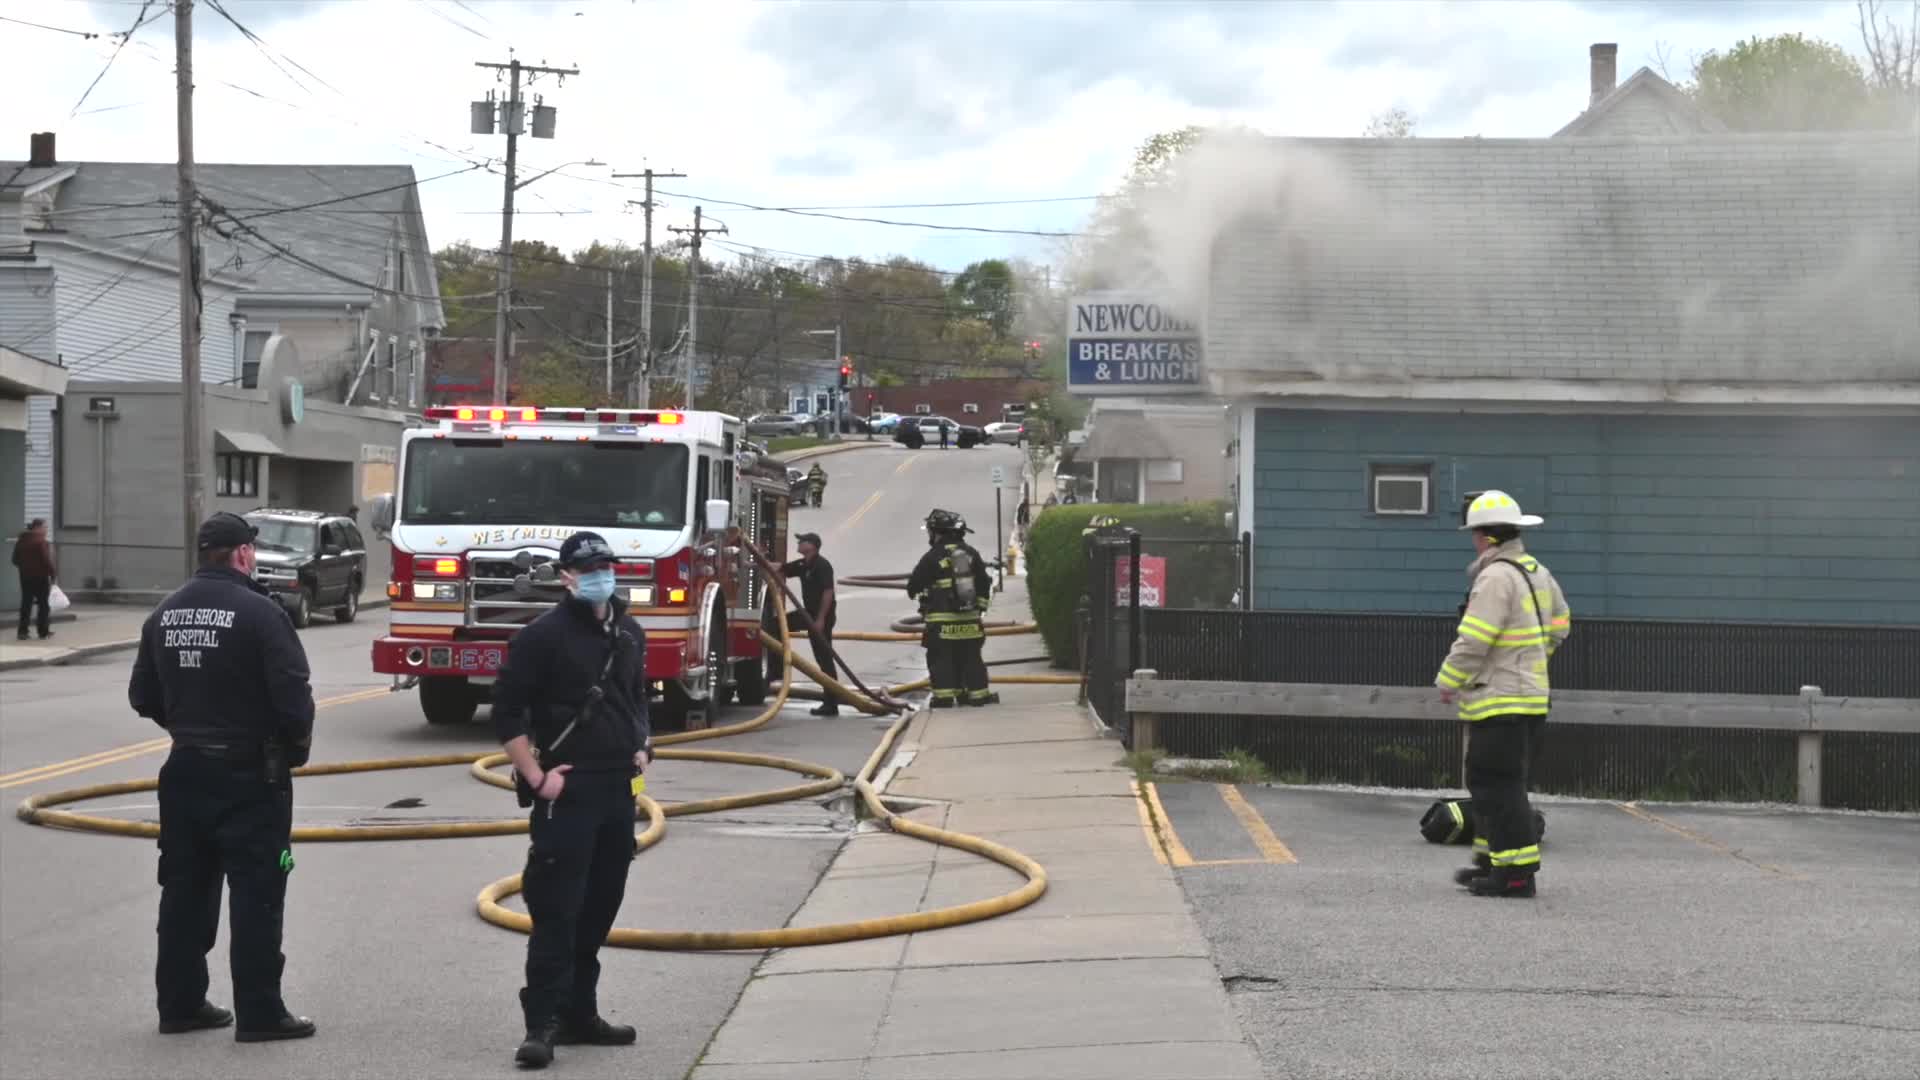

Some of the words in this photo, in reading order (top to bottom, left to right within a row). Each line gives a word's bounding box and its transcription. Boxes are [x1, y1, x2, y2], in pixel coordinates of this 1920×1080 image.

[1095, 362, 1111, 380] &
[1120, 362, 1198, 380] LUNCH
[473, 527, 574, 545] WEYMOU
[160, 609, 194, 627] SOUTH
[194, 608, 235, 628] SHORE
[165, 629, 219, 648] HOSPITAL
[179, 650, 202, 667] EMT
